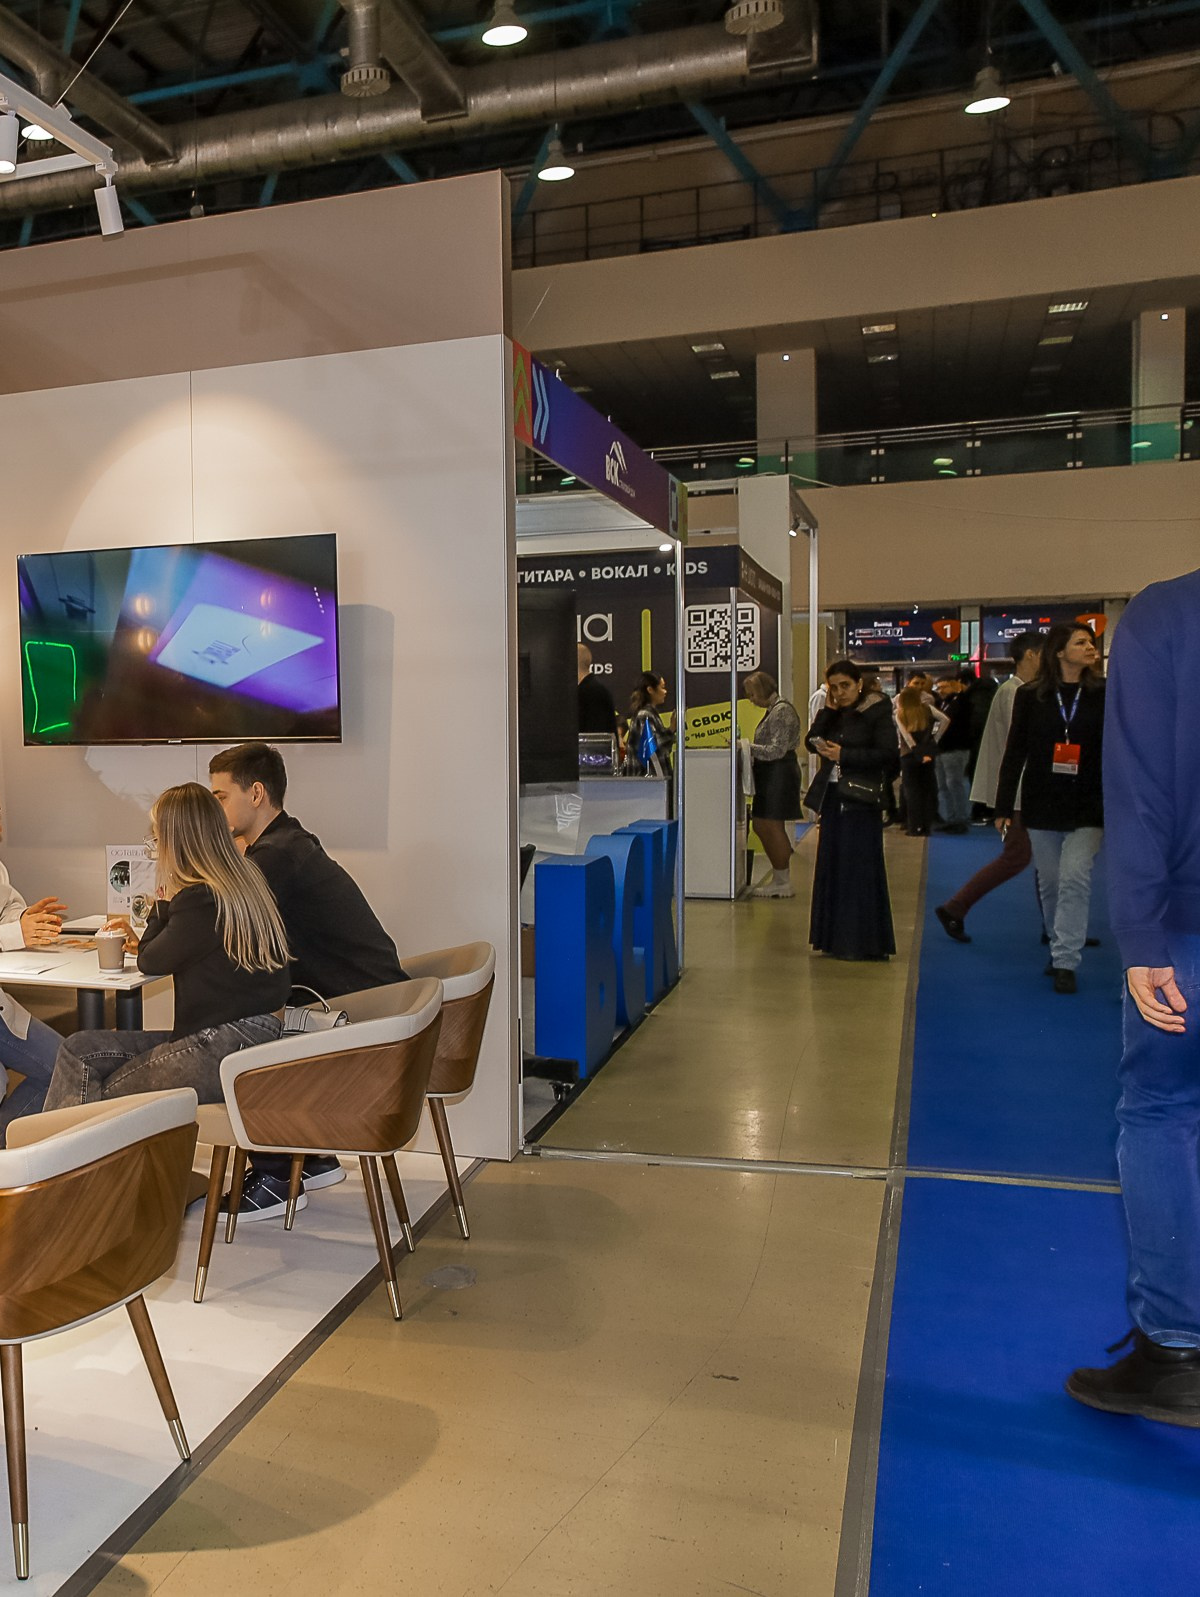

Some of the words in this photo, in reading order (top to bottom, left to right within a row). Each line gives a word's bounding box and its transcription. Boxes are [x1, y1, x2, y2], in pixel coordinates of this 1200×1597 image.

[517, 569, 575, 584] ГИТАРА
[591, 564, 648, 580] ВОКАЛ
[666, 562, 708, 577] KDS
[943, 624, 952, 639] 1
